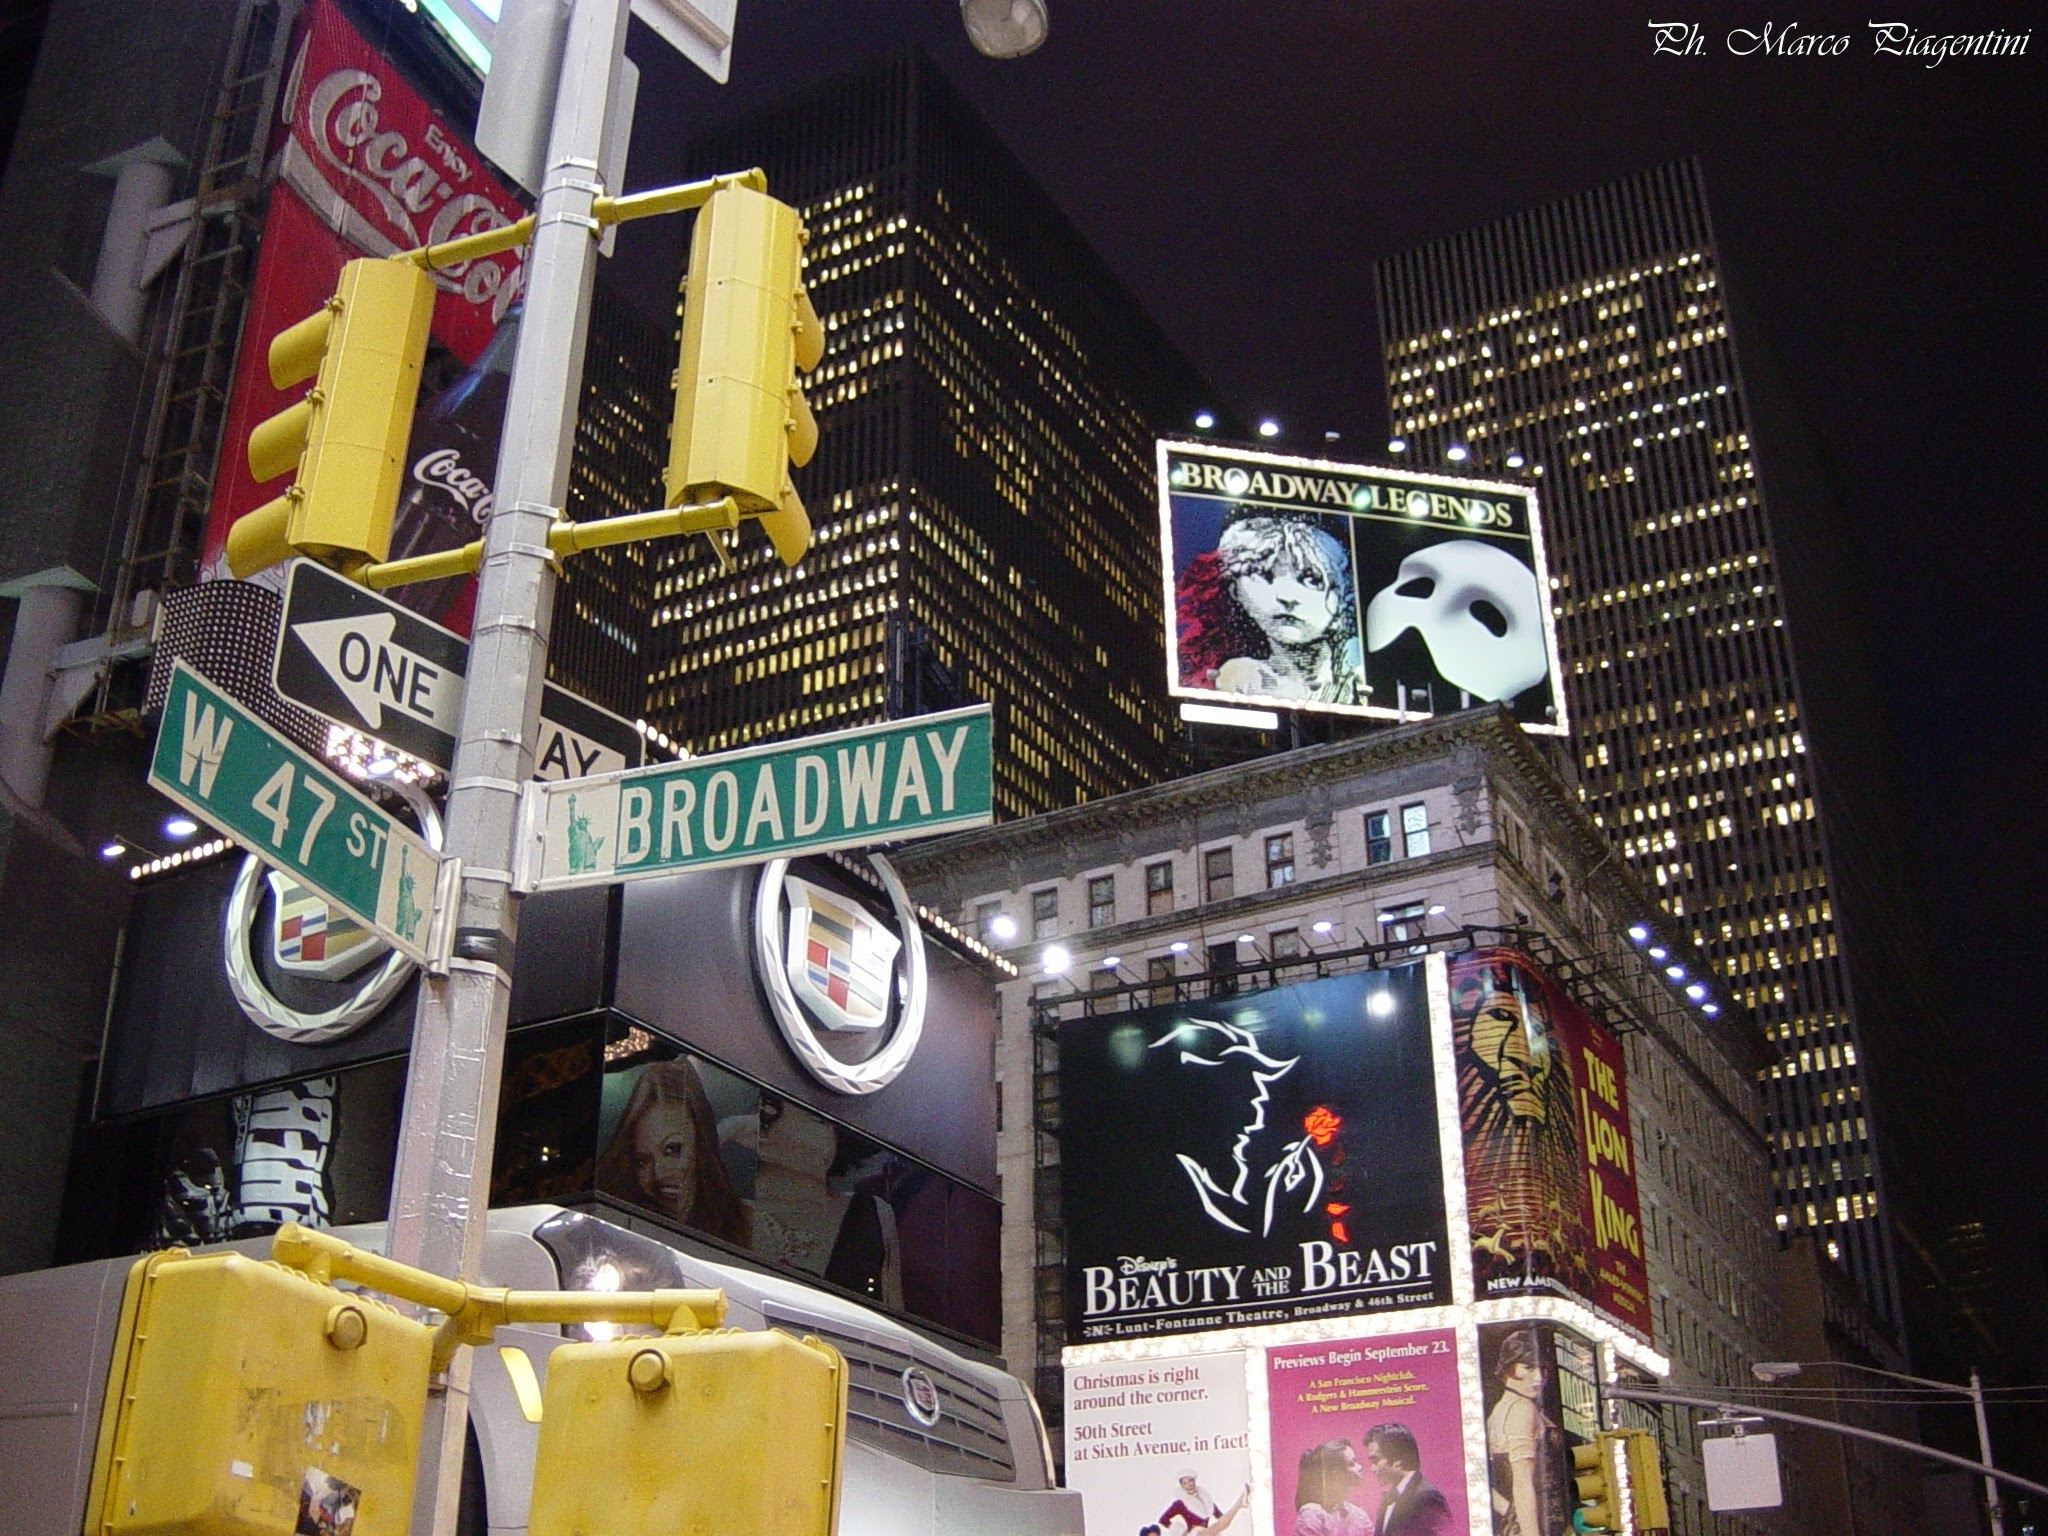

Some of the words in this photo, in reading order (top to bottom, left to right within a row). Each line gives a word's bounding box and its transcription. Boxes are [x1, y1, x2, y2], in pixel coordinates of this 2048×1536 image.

[425, 124, 473, 182] Enjoy
[413, 448, 493, 536] Coca-C
[1178, 461, 1360, 507] BROADWAY
[1370, 484, 1513, 528] LEGENDS
[338, 630, 440, 720] ONE
[539, 721, 601, 780] AY
[178, 688, 234, 800] W
[251, 761, 337, 866] 47
[345, 812, 389, 870] ST
[617, 725, 969, 865] BROADWAY
[1582, 1046, 1620, 1111] THE
[1580, 1086, 1630, 1177] LION
[1588, 1167, 1640, 1260] KING
[1082, 1264, 1247, 1316] BEAUTY
[1251, 1265, 1292, 1283] AND
[1298, 1240, 1438, 1293] BEAST
[1253, 1280, 1291, 1297] THE
[1486, 1276, 1522, 1292] NEW
[1115, 1314, 1223, 1335] Lunt-Fontanne
[1225, 1308, 1290, 1325] Theatre,
[1294, 1301, 1351, 1317] Broadway
[1354, 1298, 1365, 1309] &
[1367, 1294, 1394, 1307] 46th
[1397, 1292, 1435, 1304] Street
[1073, 1372, 1145, 1391] Christmas
[1148, 1369, 1160, 1384] is
[1163, 1366, 1200, 1386] right
[1273, 1353, 1326, 1370] Previews
[1328, 1349, 1362, 1367] Begin
[1365, 1342, 1429, 1364] September
[1431, 1340, 1450, 1355] 23.
[1073, 1391, 1126, 1411] around
[1130, 1390, 1155, 1406] the
[1156, 1386, 1209, 1404] corner.
[1073, 1423, 1107, 1442] 50th
[1110, 1422, 1153, 1439] Street
[1073, 1447, 1089, 1461] at
[1092, 1442, 1129, 1460] Sixth
[1133, 1440, 1191, 1456] Avenue,
[1194, 1436, 1209, 1451] in
[1213, 1433, 1249, 1451] fact!
